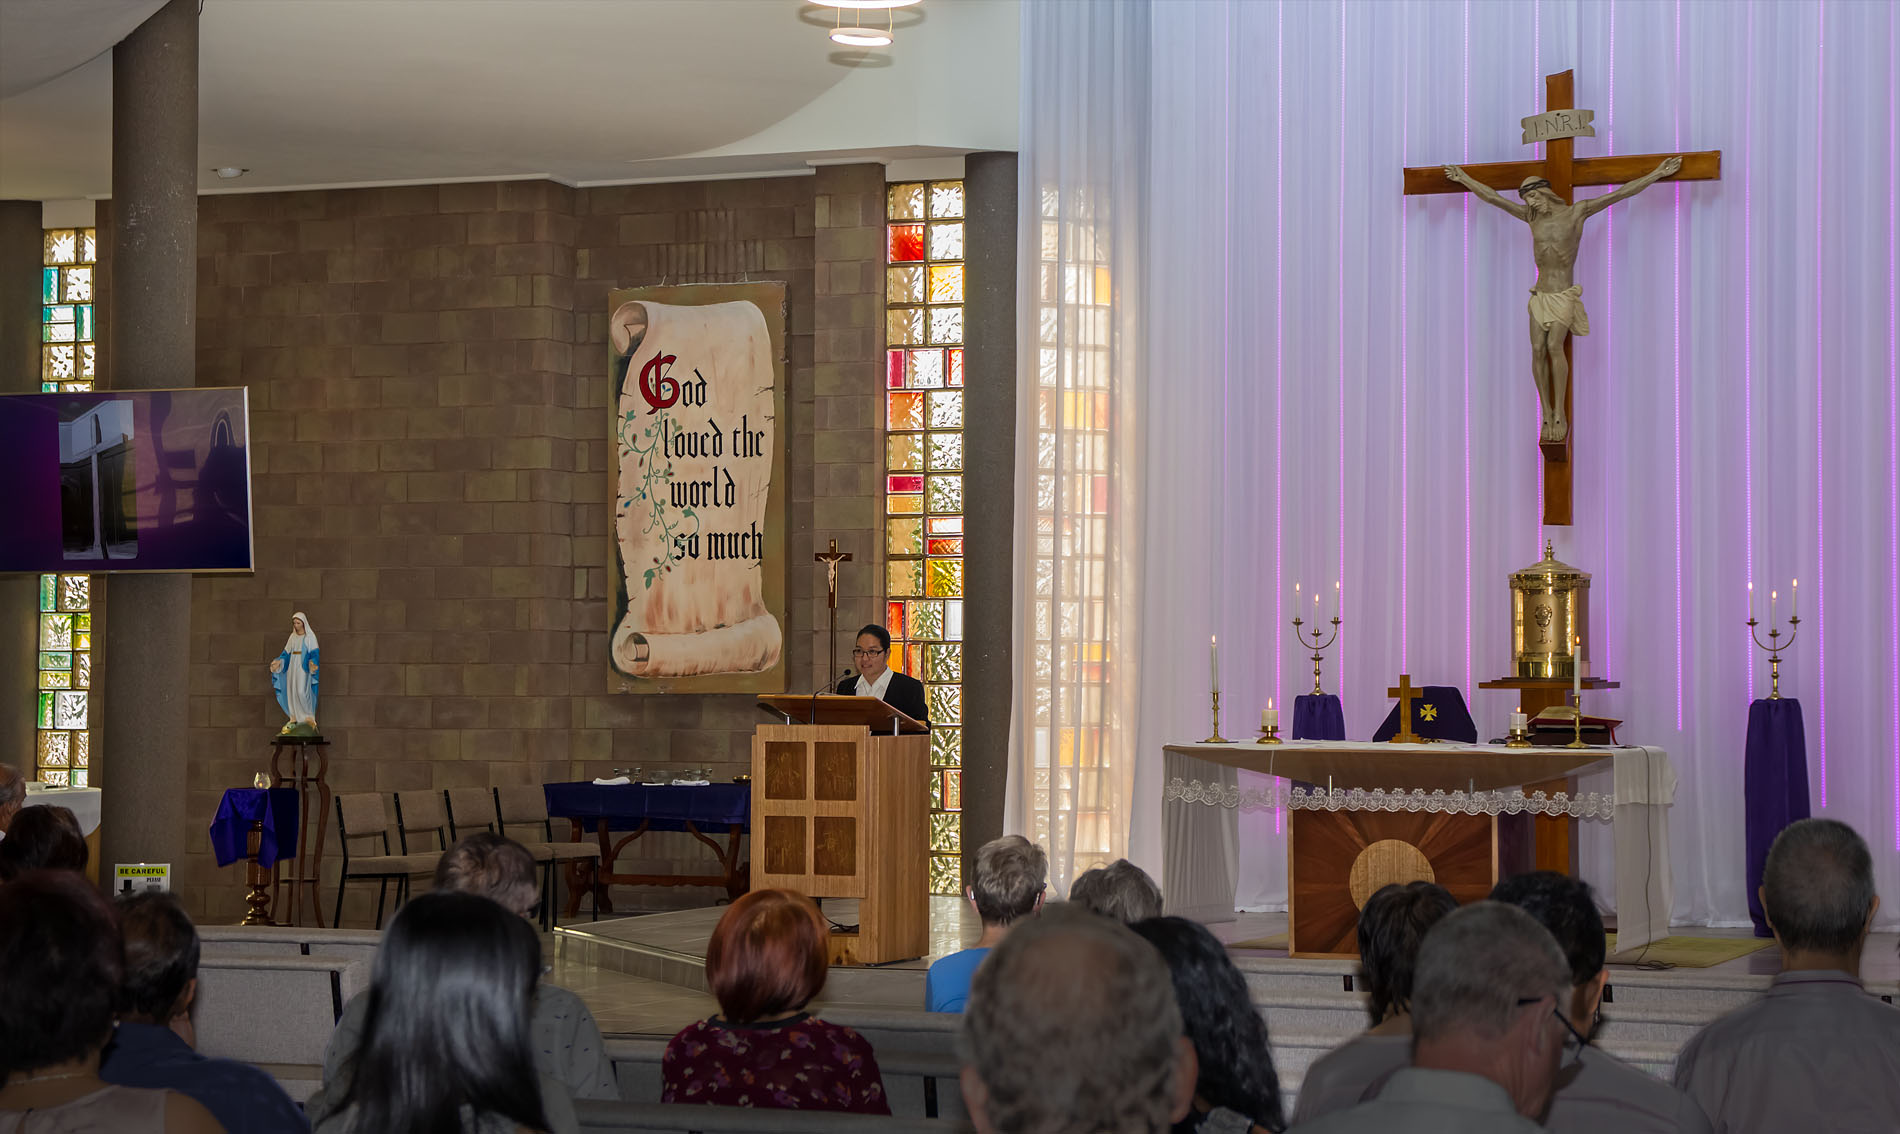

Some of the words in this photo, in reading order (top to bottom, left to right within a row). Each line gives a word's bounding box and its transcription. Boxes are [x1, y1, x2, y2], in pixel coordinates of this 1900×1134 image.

[639, 350, 708, 415] God
[664, 417, 723, 459] loved
[732, 414, 765, 458] the
[670, 465, 736, 508] world
[673, 532, 701, 561] so
[707, 521, 763, 561] much
